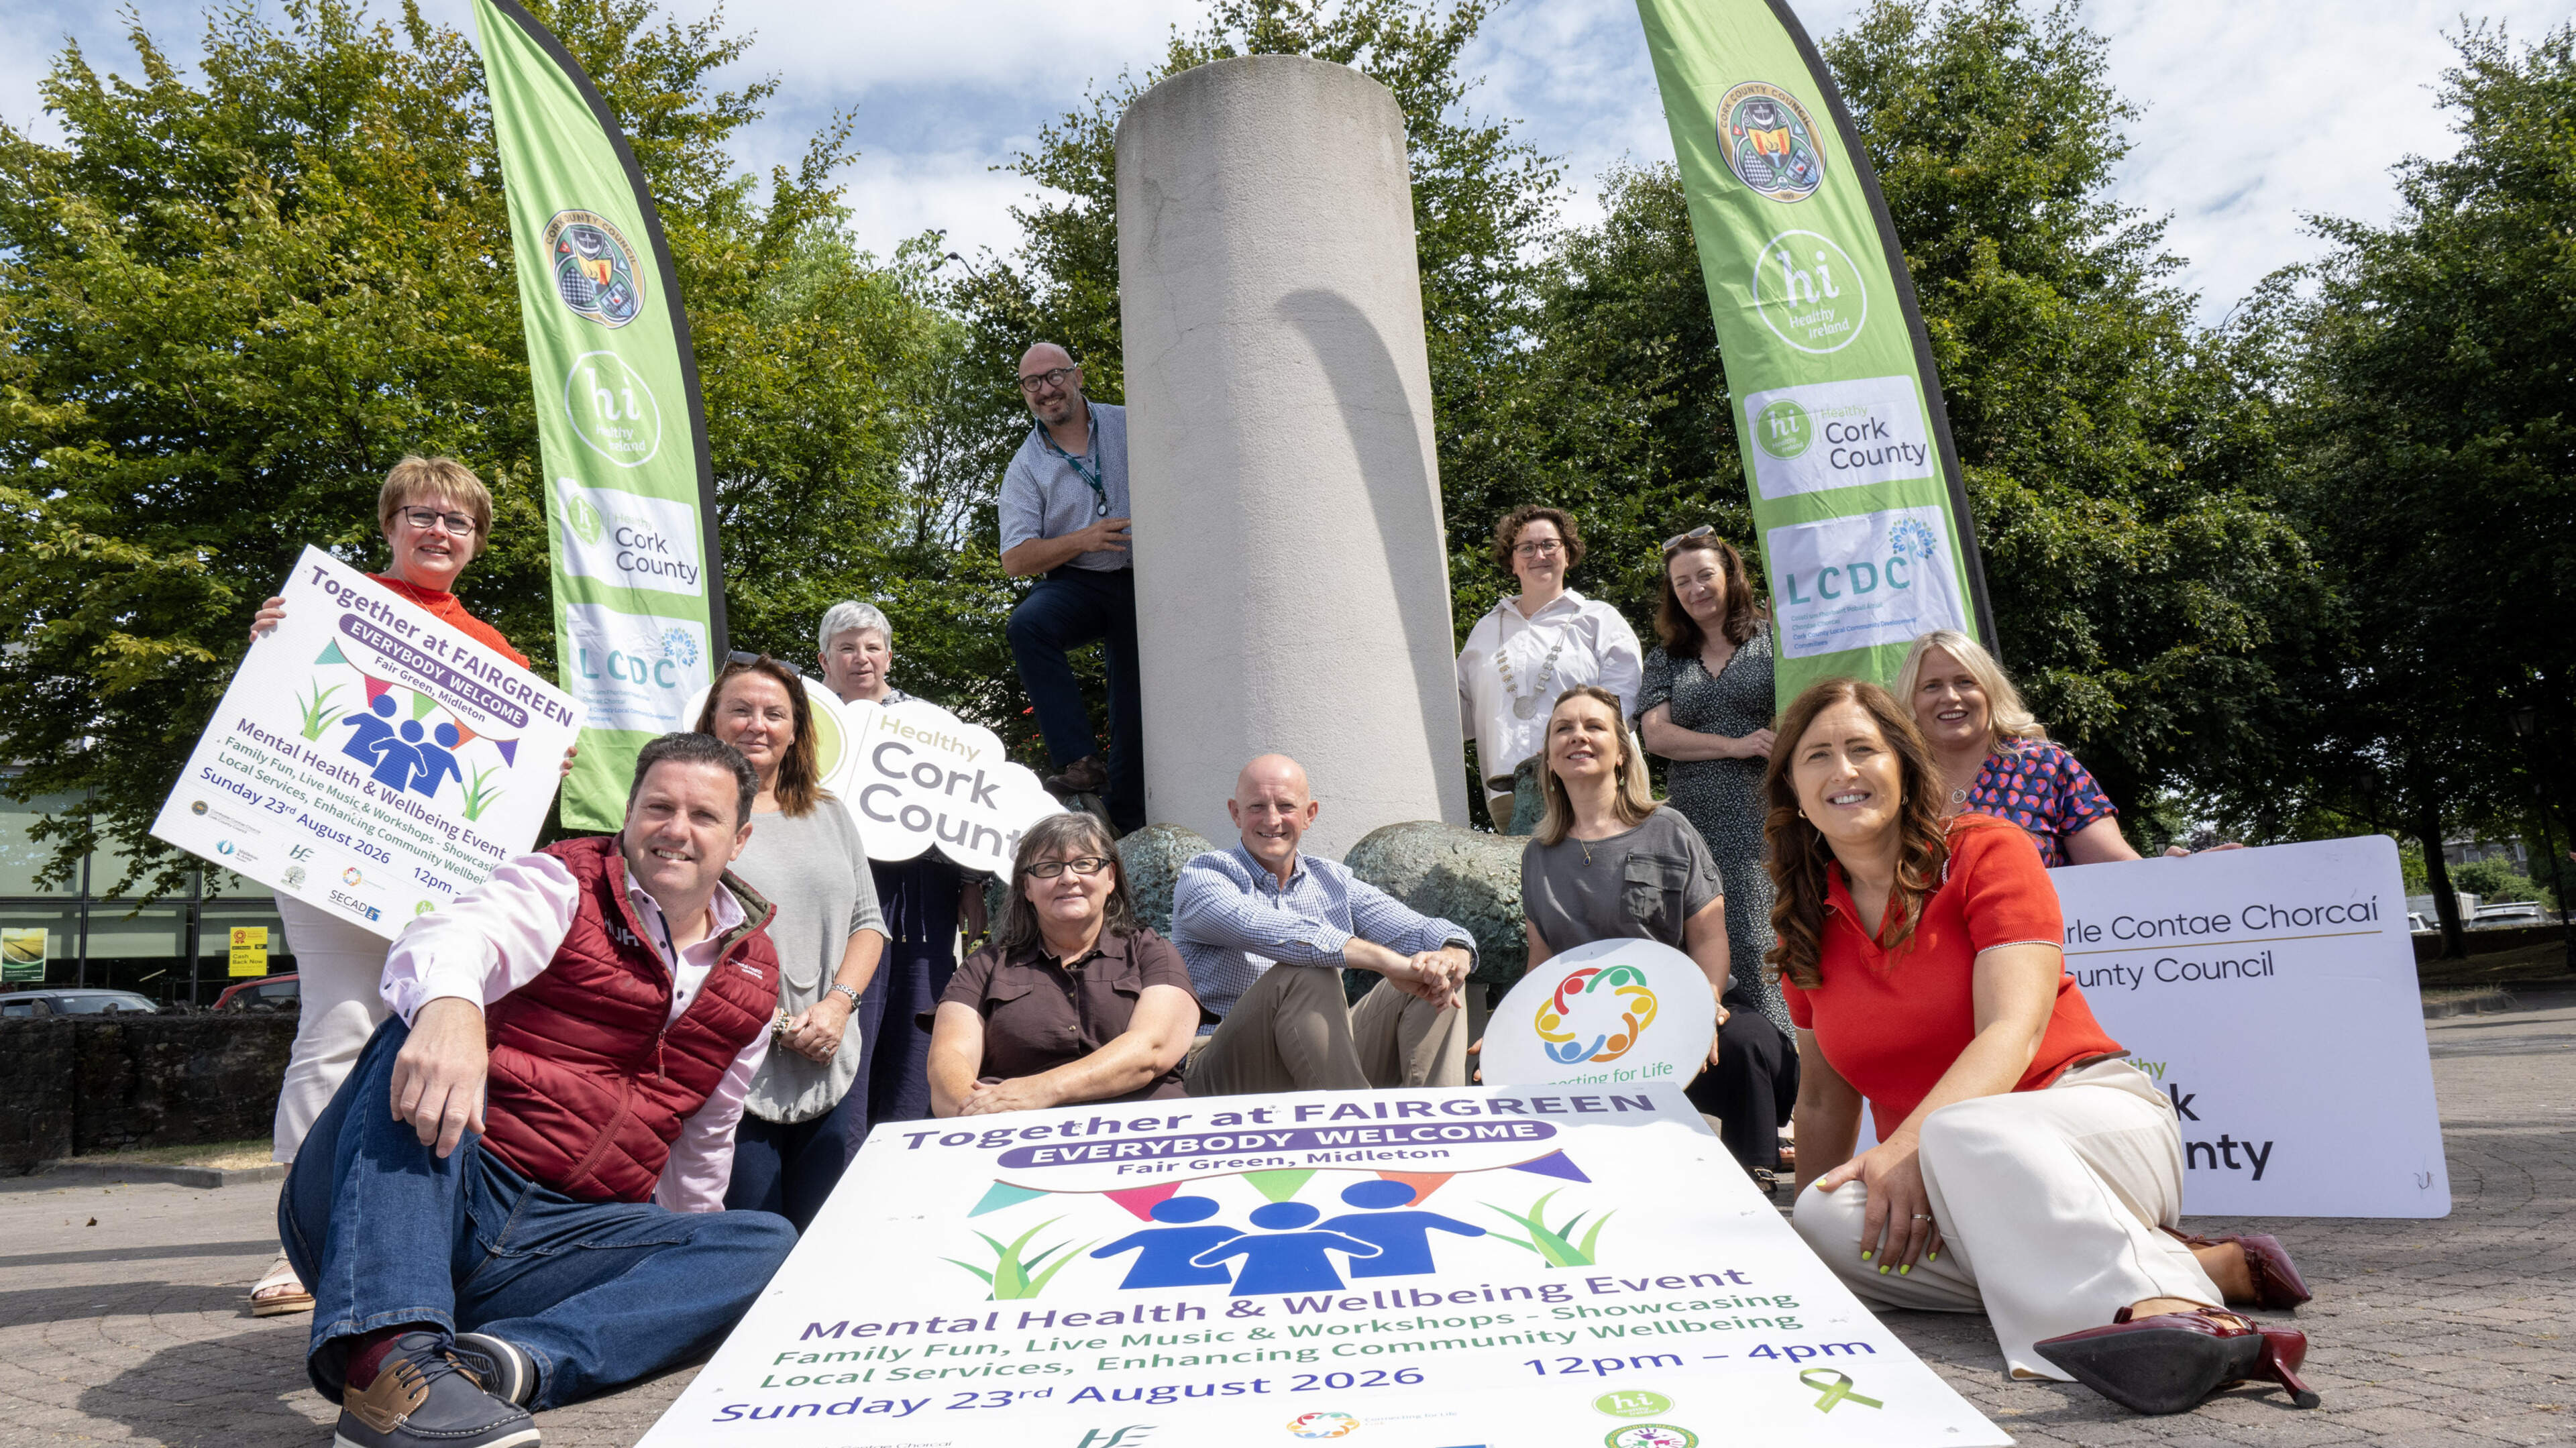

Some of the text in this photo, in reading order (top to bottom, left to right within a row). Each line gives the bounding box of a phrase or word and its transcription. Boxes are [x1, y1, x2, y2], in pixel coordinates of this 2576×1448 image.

[1721, 85, 1811, 128] CORK COUNTY COUNCIL
[545, 217, 566, 245] CORK
[602, 223, 637, 265] COUNCIL
[1776, 250, 1840, 309] hi
[1789, 307, 1835, 329] Healthy
[1809, 319, 1849, 341] Ireland
[1767, 409, 1799, 439] hi
[1821, 405, 1868, 419] Healthy
[1825, 417, 1890, 445] Cork
[1829, 441, 1926, 470] County
[615, 526, 669, 555] Cork
[616, 551, 698, 586] County
[1786, 556, 1911, 606] LCDC
[311, 565, 574, 728] Together at FAIRGREEN
[578, 647, 677, 689] LCDC
[350, 620, 524, 725] EVERYBODY WELCOME
[374, 656, 486, 723] Fair Green, Midleton
[879, 713, 981, 763] Healthy
[236, 718, 507, 860] Mental Health & Wellbeing Event
[871, 741, 1002, 810] Cork
[200, 767, 263, 805] Sunday
[264, 797, 297, 815] 23rd
[297, 814, 352, 847] August
[354, 839, 391, 864] 2026
[218, 751, 486, 885] Local Services, Enhancing Community Wellbei
[225, 736, 269, 765] Family
[270, 757, 295, 779] Fun,
[299, 772, 325, 791] Live
[326, 785, 360, 809] Music
[362, 802, 371, 814] &
[373, 807, 435, 844] Workshops
[443, 841, 494, 873] Showcasi
[859, 783, 1020, 862] Count
[329, 889, 368, 913] SECAD
[415, 867, 452, 894] 12pm
[2111, 910, 2232, 940] Contae
[2241, 895, 2379, 930] Chorcaí
[2065, 950, 2275, 991] unty Council
[1613, 1068, 1638, 1082] for
[1643, 1062, 1674, 1078] Life
[902, 1095, 1656, 1151] Together at FAIRGREEN
[1030, 1123, 1540, 1164] EVERYBODY WELCOME
[1116, 1148, 1450, 1175] Fair Green, Midleton
[2186, 1133, 2274, 1182] nty
[772, 1344, 914, 1366] Family
[923, 1342, 1011, 1359] Fun,
[1026, 1337, 1108, 1353] Live
[1120, 1329, 1236, 1348] Music
[1246, 1327, 1277, 1341] &
[1287, 1312, 1515, 1338] Workshops
[1550, 1292, 1801, 1321] Showcasing
[799, 1269, 1755, 1341] Mental Health & Wellbeing Event
[759, 1313, 1804, 1388] Local Services, Enhancing Community Wellbeing
[711, 1396, 932, 1423] Sunday
[945, 1386, 1054, 1410] 23rd
[1067, 1377, 1272, 1406] August
[1289, 1367, 1425, 1393] 2026
[1523, 1350, 1684, 1377] 12pm
[1747, 1339, 1877, 1364] 4pm
[1609, 1393, 1654, 1409] hi
